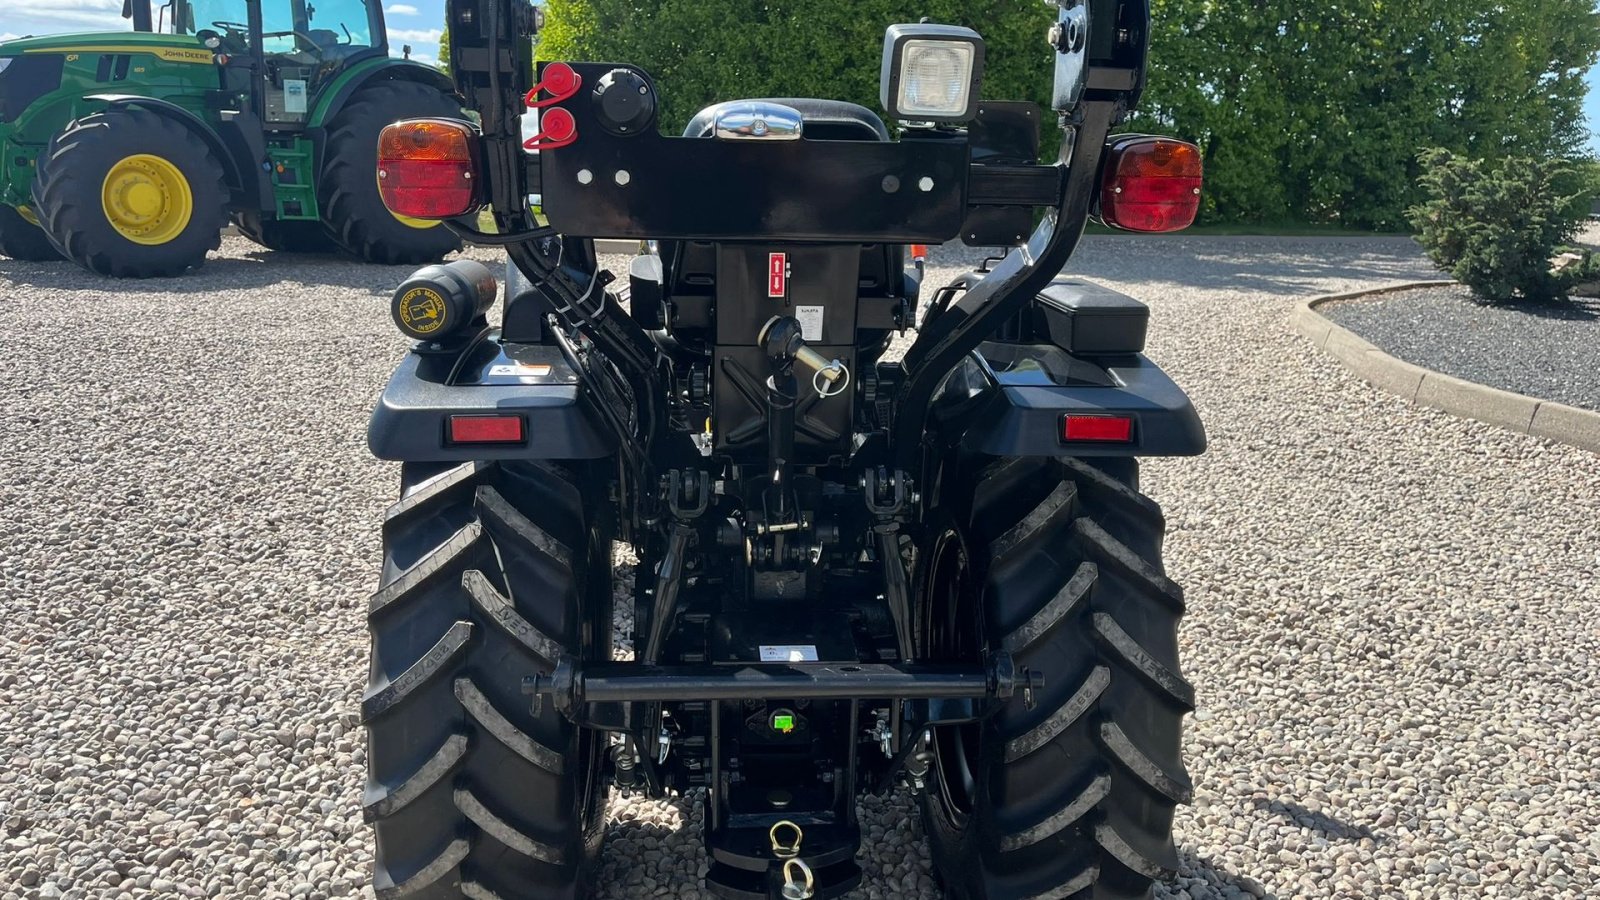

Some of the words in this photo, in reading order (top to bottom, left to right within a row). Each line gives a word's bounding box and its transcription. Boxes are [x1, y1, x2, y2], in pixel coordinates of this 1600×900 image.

[66, 54, 79, 62] 6R
[163, 50, 184, 58] JOHN
[184, 51, 209, 60] DEERE
[401, 290, 421, 322] OPERATOR'S
[424, 290, 443, 312] MANUAL
[417, 320, 439, 331] INSIDE
